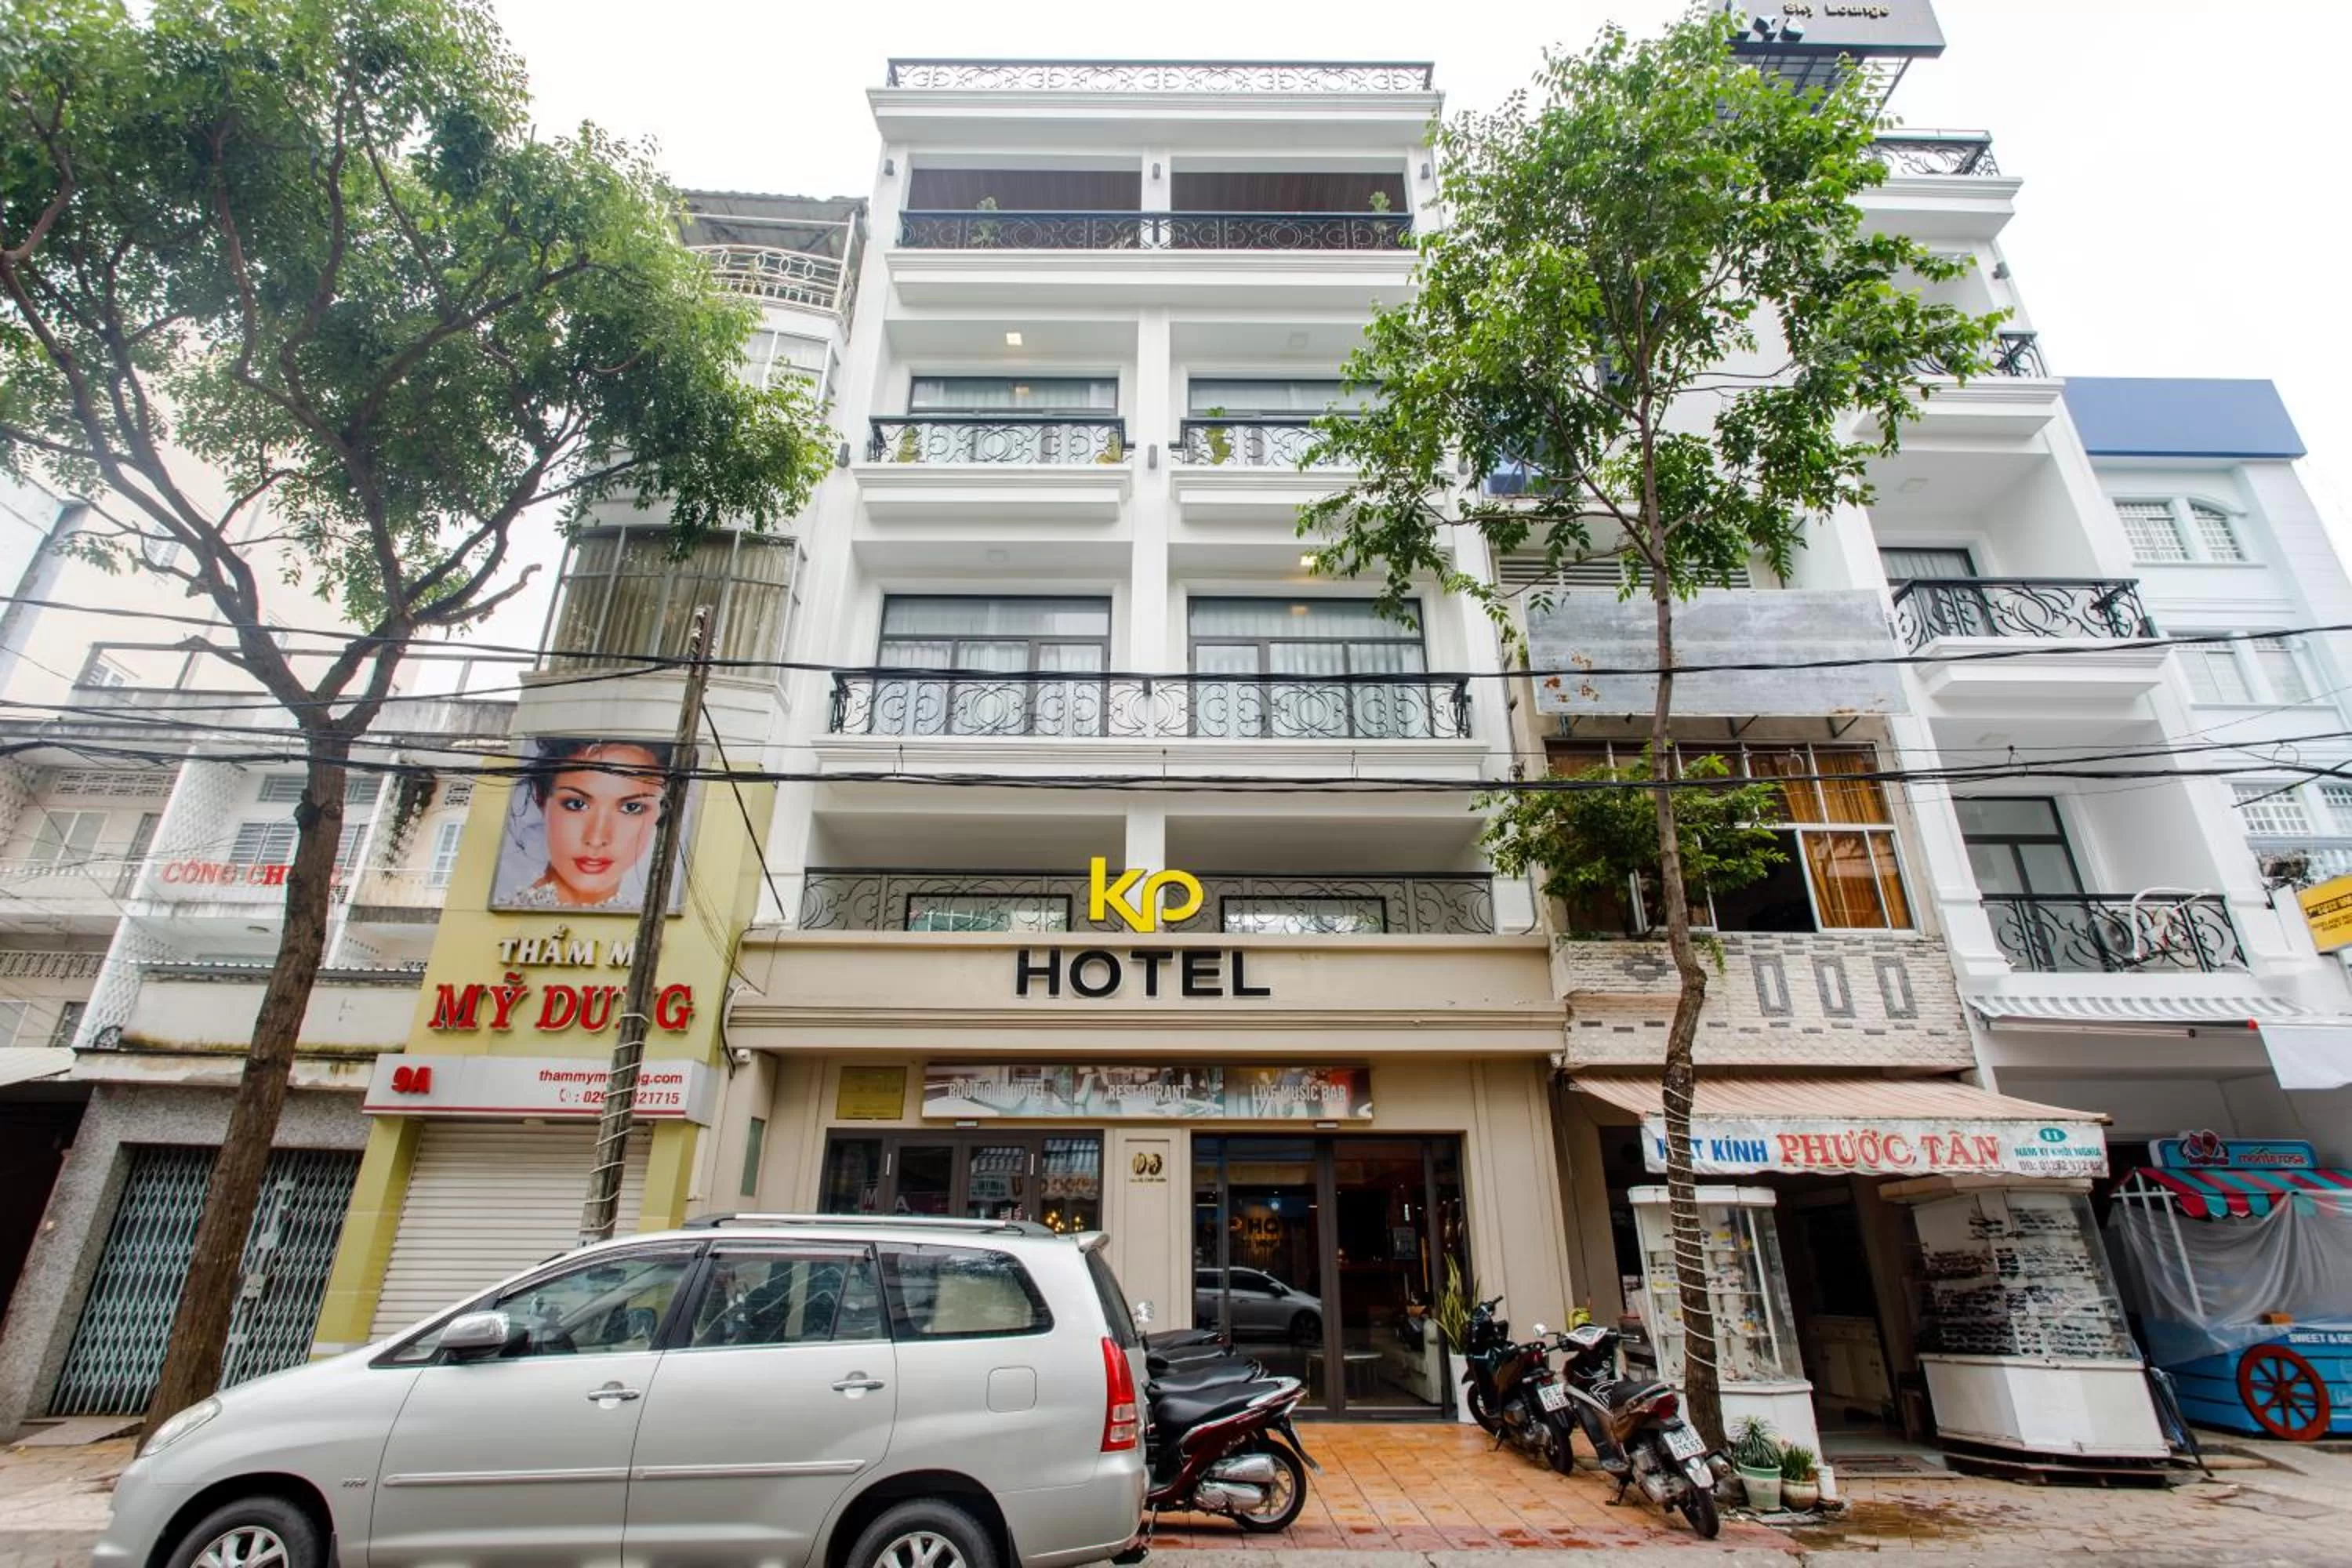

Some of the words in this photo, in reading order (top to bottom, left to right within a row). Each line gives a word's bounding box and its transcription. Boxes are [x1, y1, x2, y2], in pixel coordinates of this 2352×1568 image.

[1824, 2, 1890, 19] Lounge
[499, 924, 597, 966] THẨM
[1016, 949, 1272, 998] HOTEL
[428, 971, 529, 1031] MỸ
[535, 983, 694, 1032] DUG
[391, 1066, 432, 1094] 9A
[1012, 1081, 1045, 1098] HOTEL
[1107, 1084, 1189, 1102] RESTAURANT
[1250, 1085, 1277, 1102] LIVE
[1279, 1085, 1319, 1102] MUSIC
[1321, 1084, 1347, 1102] BAR
[1711, 1135, 1769, 1162] KÍNH
[1777, 1129, 1916, 1167] PHƯỚC
